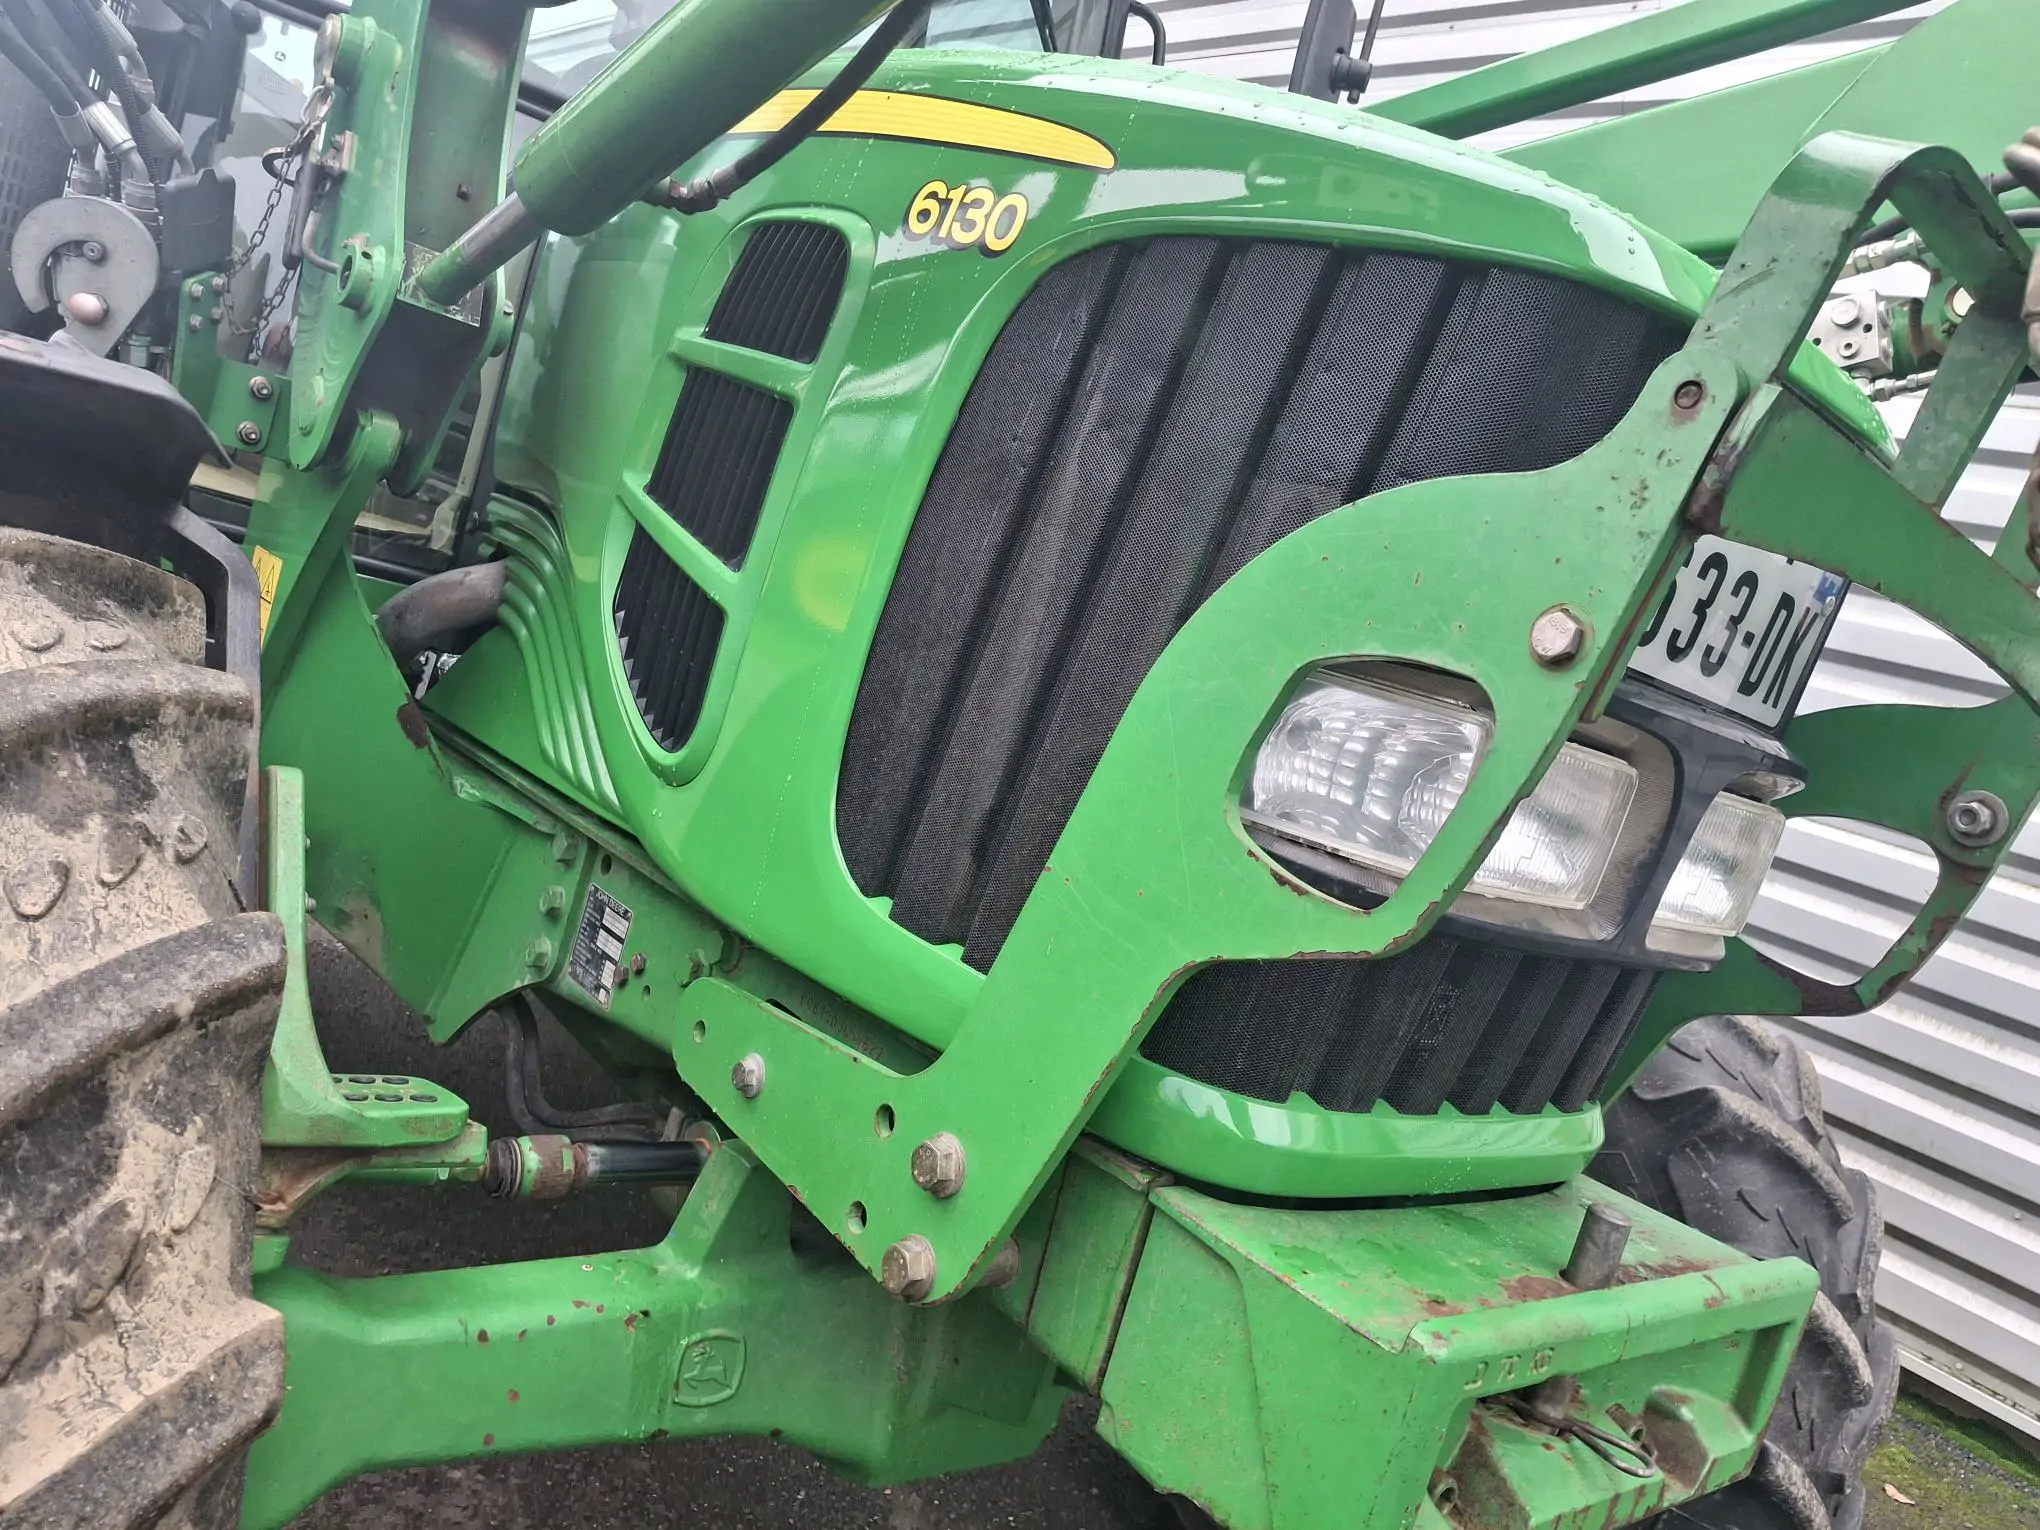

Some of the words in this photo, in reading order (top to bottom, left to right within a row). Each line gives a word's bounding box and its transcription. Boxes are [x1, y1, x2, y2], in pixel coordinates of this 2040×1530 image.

[903, 179, 1029, 254] 6130
[595, 889, 610, 905] JOHN
[608, 898, 626, 917] DEERE
